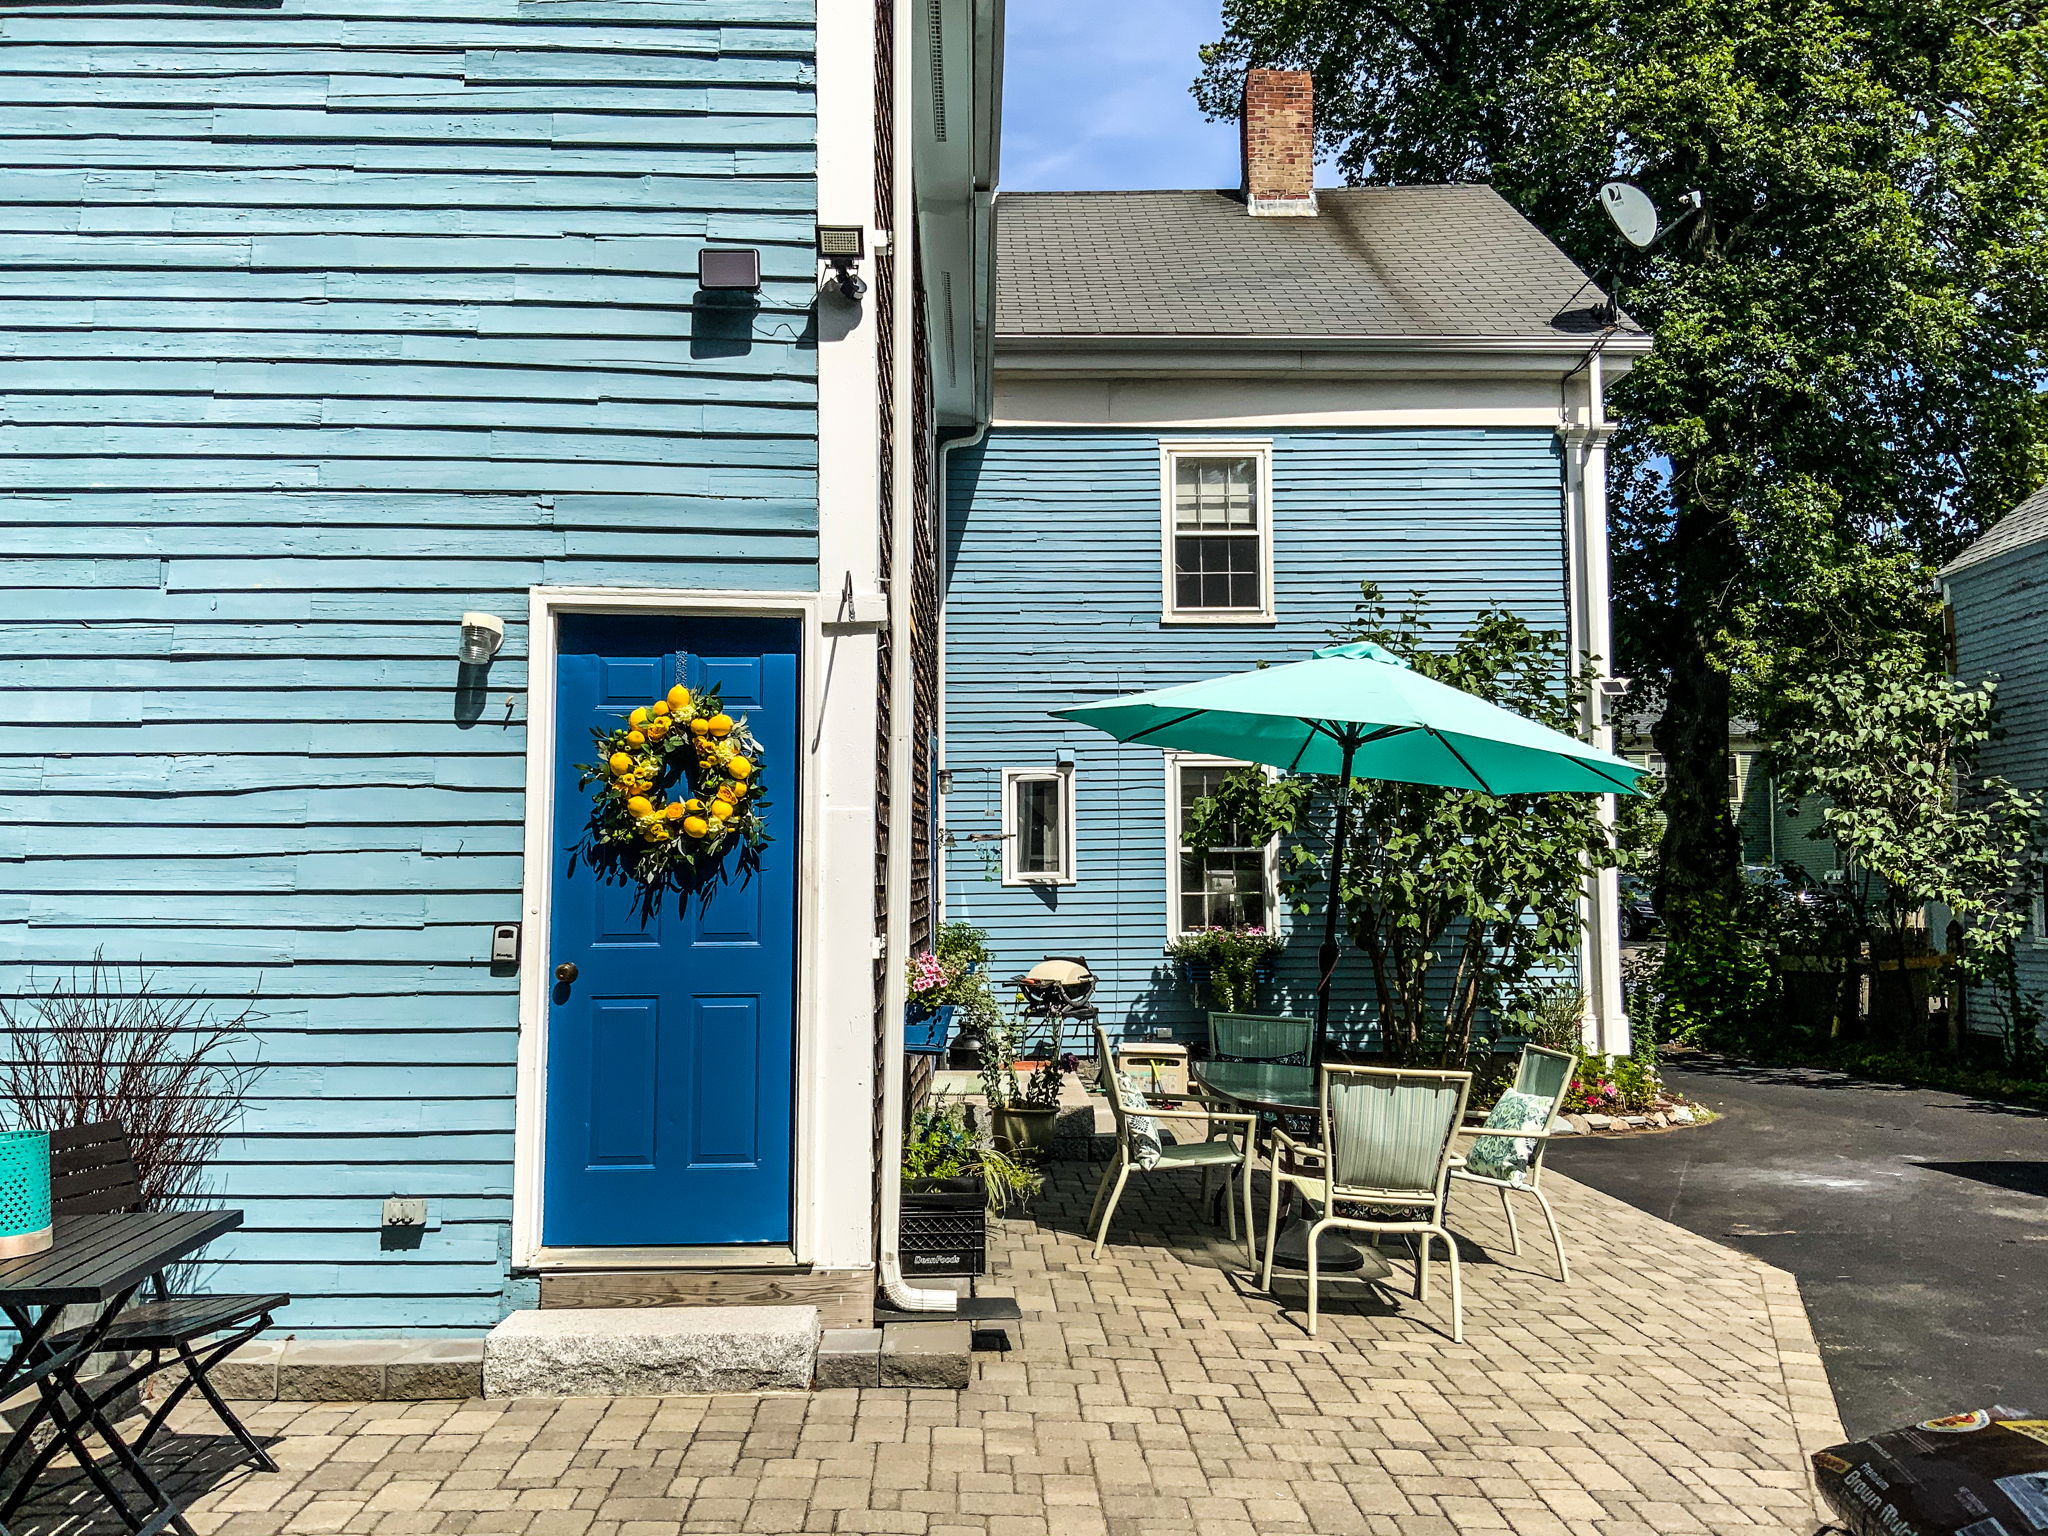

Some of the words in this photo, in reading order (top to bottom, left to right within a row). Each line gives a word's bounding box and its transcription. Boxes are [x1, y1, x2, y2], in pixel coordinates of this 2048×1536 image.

[1860, 1462, 1890, 1491] Premium
[1844, 1470, 1882, 1511] Brown
[1879, 1503, 1919, 1536] Mulc
